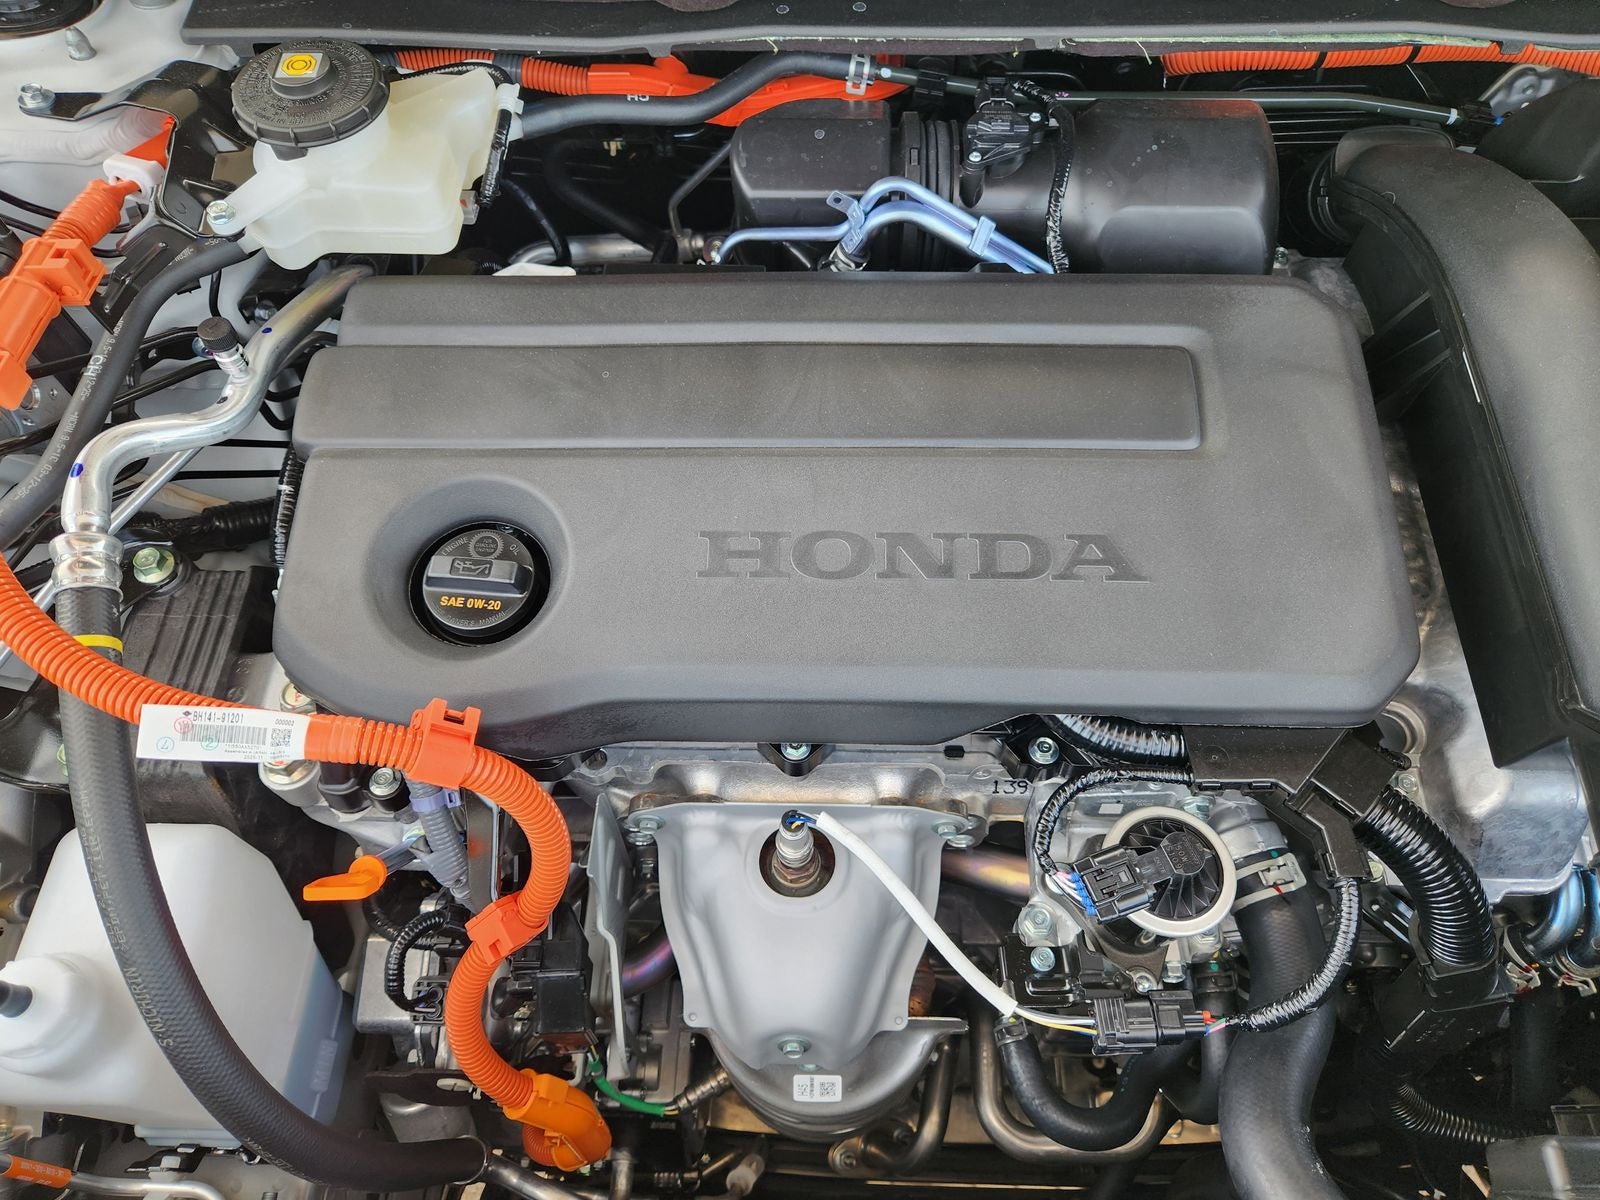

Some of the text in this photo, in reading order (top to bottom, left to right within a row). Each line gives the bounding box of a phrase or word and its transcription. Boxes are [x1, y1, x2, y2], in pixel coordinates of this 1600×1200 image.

[83, 354, 104, 376] CH
[441, 536, 520, 556] ENGINE OIL
[695, 529, 1150, 583] HONDA
[440, 595, 502, 611] SAE 0W-20
[192, 710, 244, 724] BH141-91201
[992, 780, 1029, 795] 139
